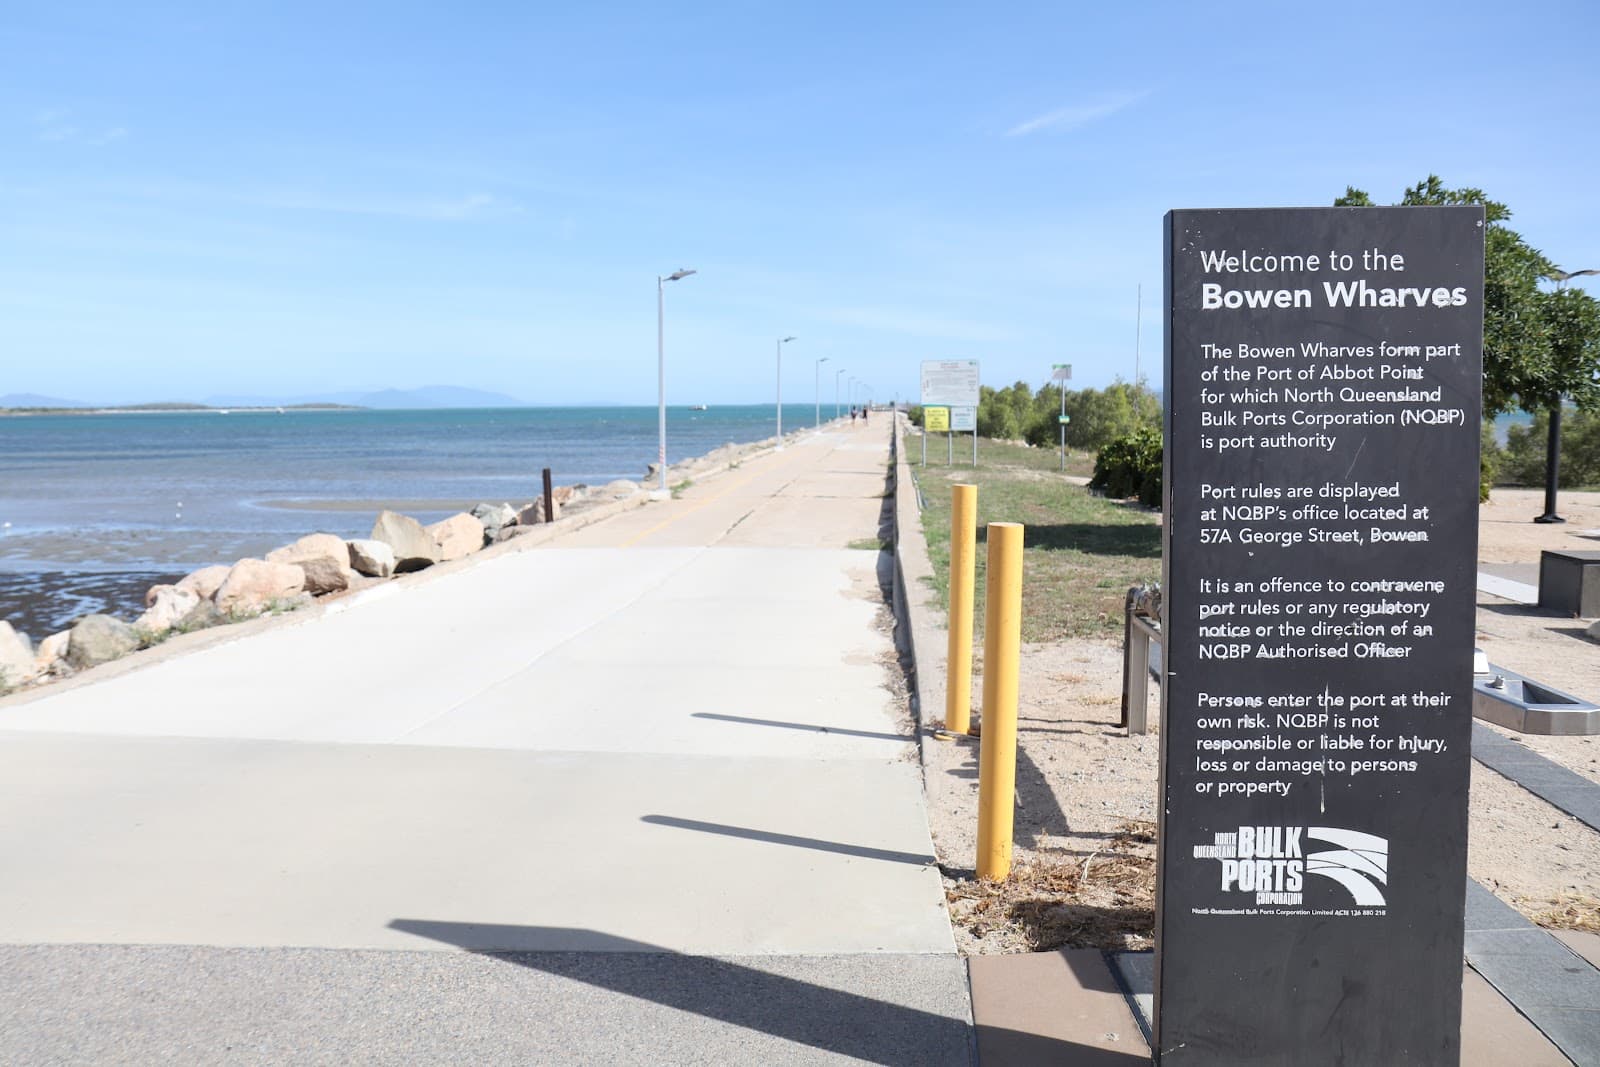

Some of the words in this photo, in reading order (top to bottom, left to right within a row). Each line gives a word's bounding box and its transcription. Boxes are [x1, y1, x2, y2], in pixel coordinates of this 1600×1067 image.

[1199, 249, 1321, 274] Welcome
[1328, 250, 1354, 272] to
[1362, 247, 1405, 272] the
[1201, 282, 1312, 311] Bowen
[1322, 279, 1468, 309] Wharves
[1200, 343, 1233, 360] The
[1238, 343, 1296, 359] Bowen
[1300, 341, 1375, 358] Wharves
[1378, 340, 1422, 357] form
[1425, 342, 1462, 362] part
[1200, 365, 1219, 382] of
[1222, 365, 1252, 382] the
[1256, 365, 1293, 381] Port
[1297, 363, 1316, 381] of
[1319, 363, 1375, 380] Abbot
[1380, 364, 1425, 380] Point
[1200, 387, 1226, 405] for
[1229, 386, 1279, 404] which
[1284, 386, 1334, 403] North
[1339, 385, 1442, 403] Queensland
[1201, 410, 1238, 427] Bulk
[1242, 410, 1287, 426] Ports
[1291, 409, 1395, 431] Corporation
[1400, 408, 1465, 427] (NQBP)
[1200, 432, 1214, 449] is
[1218, 434, 1255, 454] port
[1260, 431, 1337, 452] authority
[1201, 483, 1237, 500] Port
[1241, 482, 1282, 500] rules
[1286, 487, 1314, 498] are
[1318, 481, 1401, 503] displayed
[1200, 507, 1217, 522] at
[1222, 505, 1287, 521] NQBP's
[1291, 503, 1339, 521] office
[1344, 503, 1407, 521] located
[1412, 506, 1430, 521] at
[1199, 528, 1233, 544] 57A
[1238, 527, 1303, 548] George
[1307, 527, 1364, 547] Street,
[1370, 527, 1430, 544] Bowen
[1200, 578, 1212, 594] It
[1216, 578, 1230, 594] is
[1233, 582, 1254, 593] an
[1259, 576, 1323, 593] offence
[1326, 579, 1346, 593] to
[1350, 578, 1445, 594] contravene
[1199, 601, 1236, 620] port
[1240, 598, 1280, 616] rules
[1285, 603, 1304, 615] or
[1308, 603, 1338, 619] any
[1343, 598, 1431, 618] regulatory
[1199, 621, 1251, 638] notice
[1255, 625, 1274, 638] or
[1277, 620, 1306, 637] the
[1310, 620, 1385, 637] direction
[1390, 619, 1408, 636] of
[1412, 624, 1433, 638] an
[1199, 643, 1252, 661] NQBP
[1255, 641, 1349, 659] Authorised
[1353, 641, 1413, 659] Officer
[1197, 692, 1265, 709] Persons
[1267, 693, 1313, 708] enter
[1316, 691, 1345, 708] the
[1349, 693, 1387, 712] port
[1390, 693, 1408, 708] at
[1411, 690, 1452, 708] their
[1196, 717, 1232, 729] own
[1237, 712, 1271, 729] risk.
[1276, 713, 1329, 729] NQBP
[1333, 713, 1347, 729] is
[1351, 715, 1380, 729] not
[1196, 733, 1292, 755] responsible
[1296, 739, 1316, 750] or
[1320, 733, 1365, 750] liable
[1368, 733, 1394, 750] for
[1398, 735, 1448, 754] injury,
[1196, 755, 1228, 773] loss
[1231, 760, 1251, 772] or
[1255, 755, 1323, 776] damage
[1326, 758, 1346, 772] to
[1350, 760, 1419, 776] persons
[1195, 782, 1214, 794] or
[1218, 779, 1293, 798] property
[1215, 832, 1237, 845] NORTH
[1238, 826, 1302, 858] BULK
[1193, 845, 1236, 859] QUEENSLAND
[1222, 859, 1303, 892] PORTS
[1256, 892, 1303, 905] CORPORATION
[1311, 908, 1334, 916] Limited
